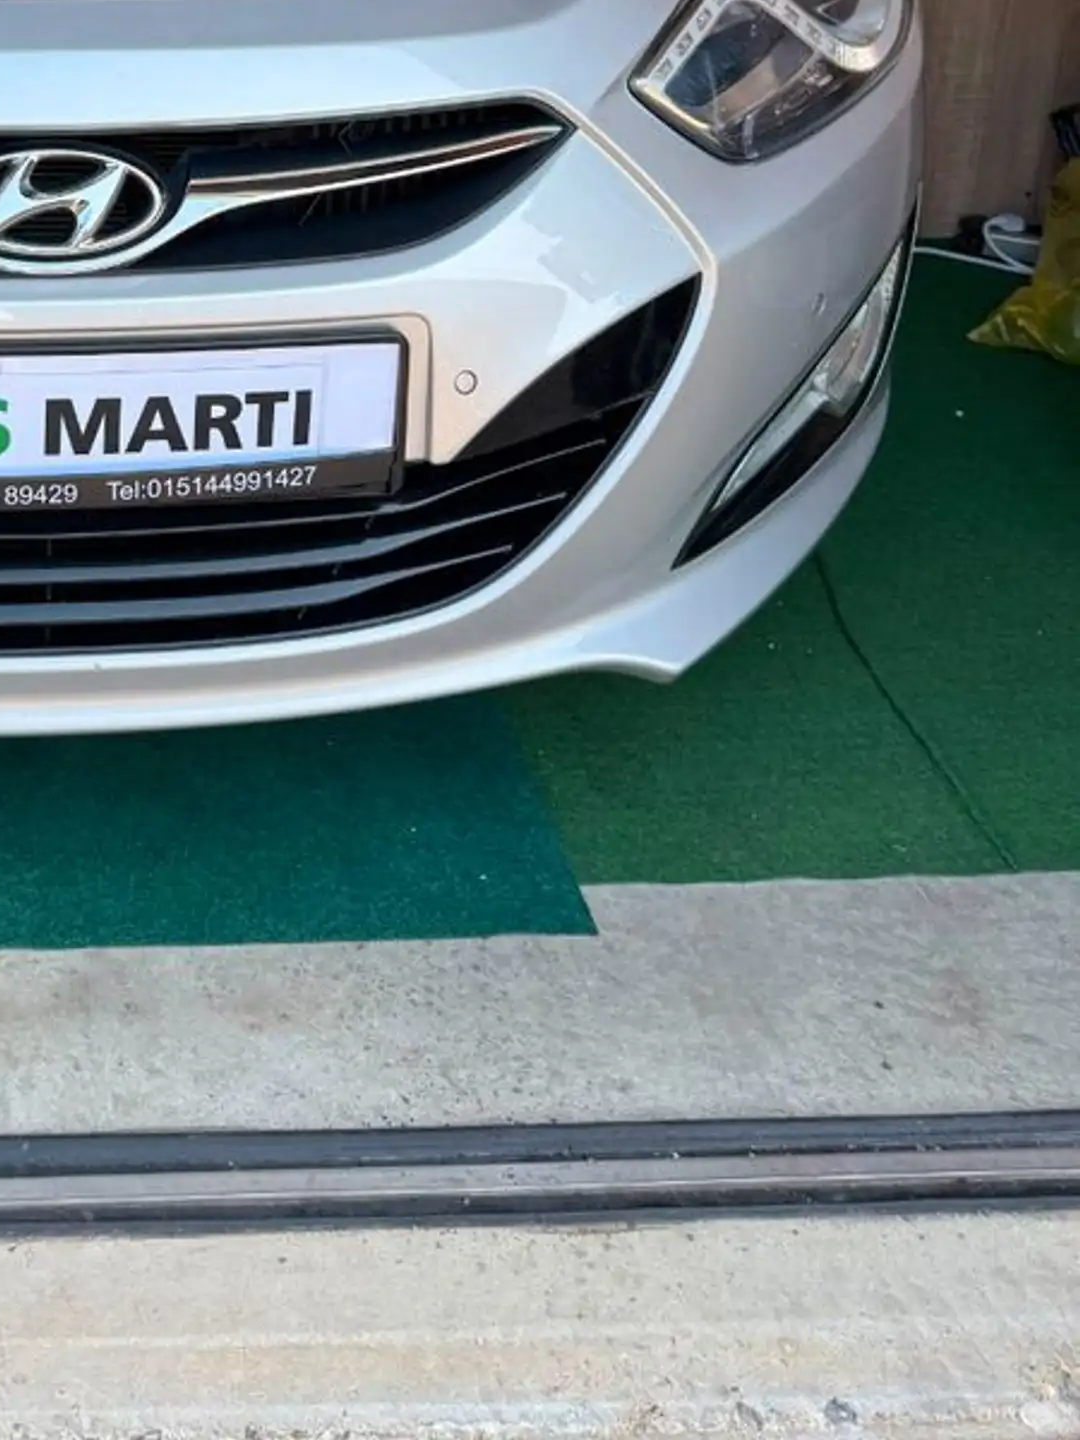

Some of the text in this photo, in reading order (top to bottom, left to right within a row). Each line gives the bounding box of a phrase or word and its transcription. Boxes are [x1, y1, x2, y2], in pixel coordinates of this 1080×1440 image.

[44, 390, 313, 456] MARTI
[4, 484, 79, 506] 89429
[106, 466, 317, 501] Tel:015144991427
